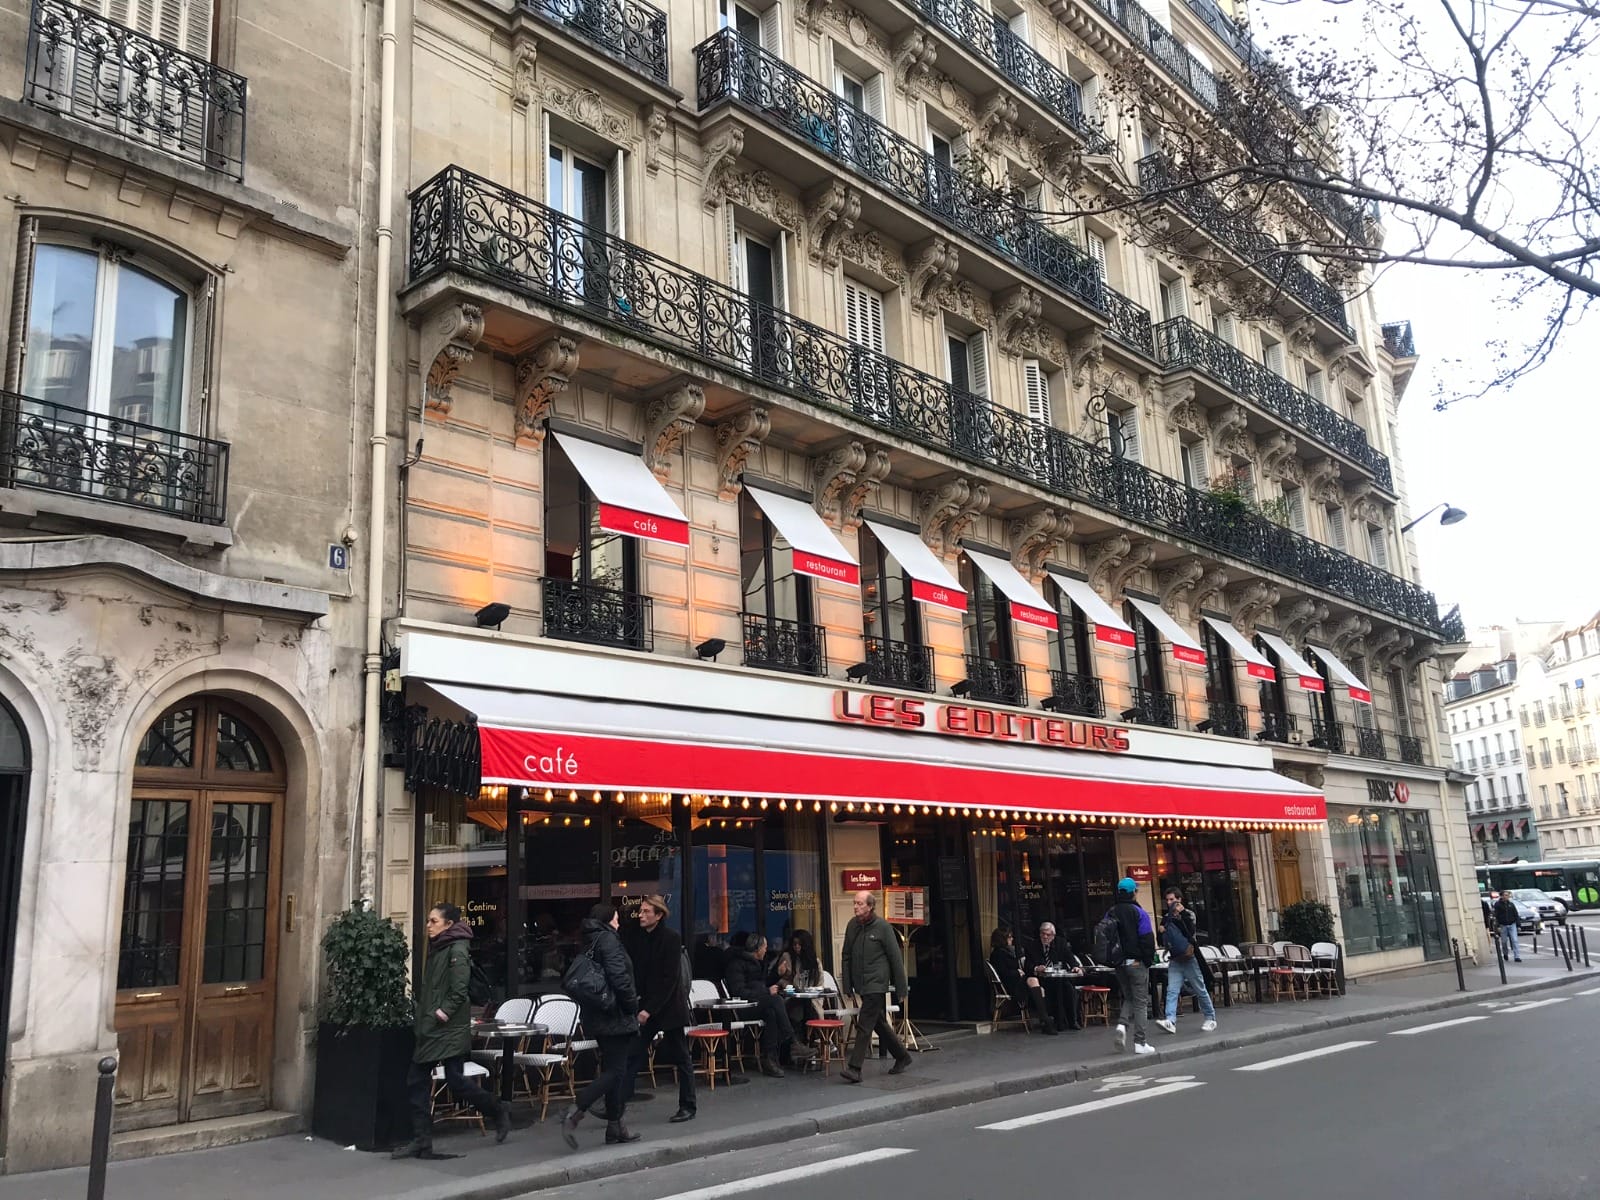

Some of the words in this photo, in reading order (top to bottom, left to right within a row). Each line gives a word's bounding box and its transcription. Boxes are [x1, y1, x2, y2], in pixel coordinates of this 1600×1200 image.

[633, 519, 658, 533] café
[333, 547, 343, 566] 6
[805, 560, 846, 577] restaurant
[932, 590, 949, 602] café
[1019, 609, 1049, 624] restaurant
[834, 689, 925, 728] LES
[938, 704, 1130, 752] EDITEURS
[523, 746, 579, 775] café
[1366, 779, 1396, 802] HSBC
[1283, 804, 1318, 816] restaurant
[467, 900, 497, 912] Continu
